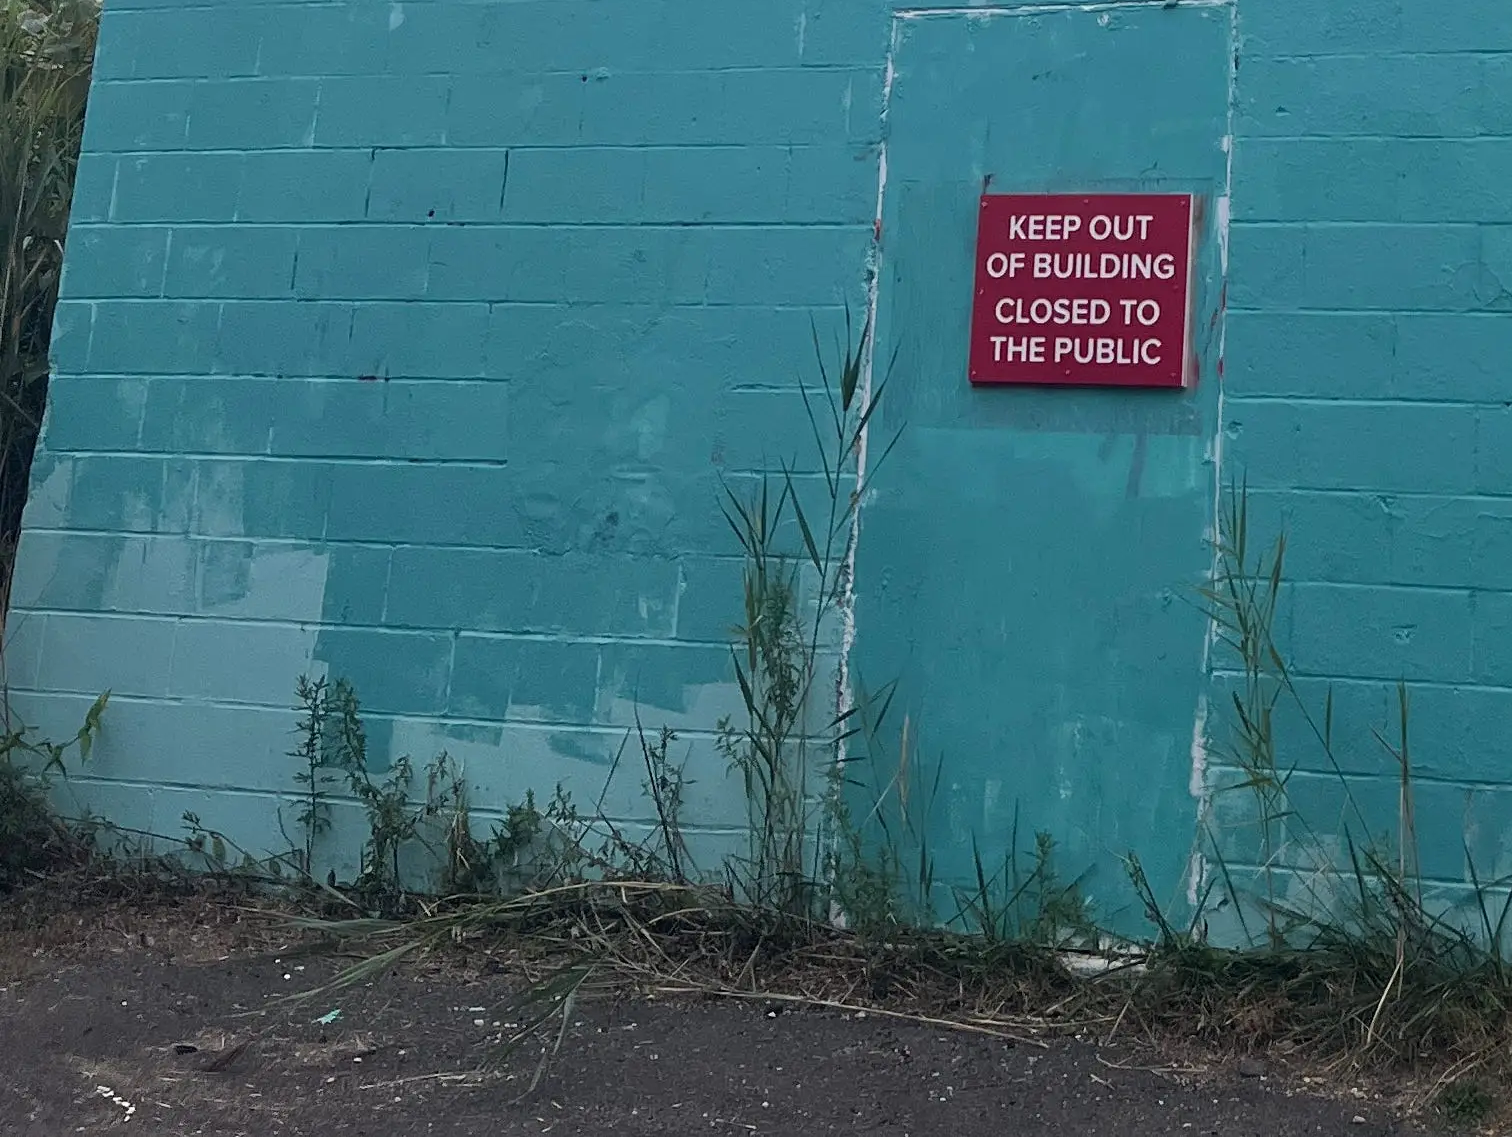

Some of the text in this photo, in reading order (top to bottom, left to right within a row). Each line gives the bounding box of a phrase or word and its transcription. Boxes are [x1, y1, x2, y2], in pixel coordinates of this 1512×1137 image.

[1009, 215, 1154, 240] KEEP OUT
[986, 252, 1175, 279] OF BUILDING
[995, 298, 1161, 326] CLOSED TO
[990, 336, 1162, 365] THE PUBLIC
